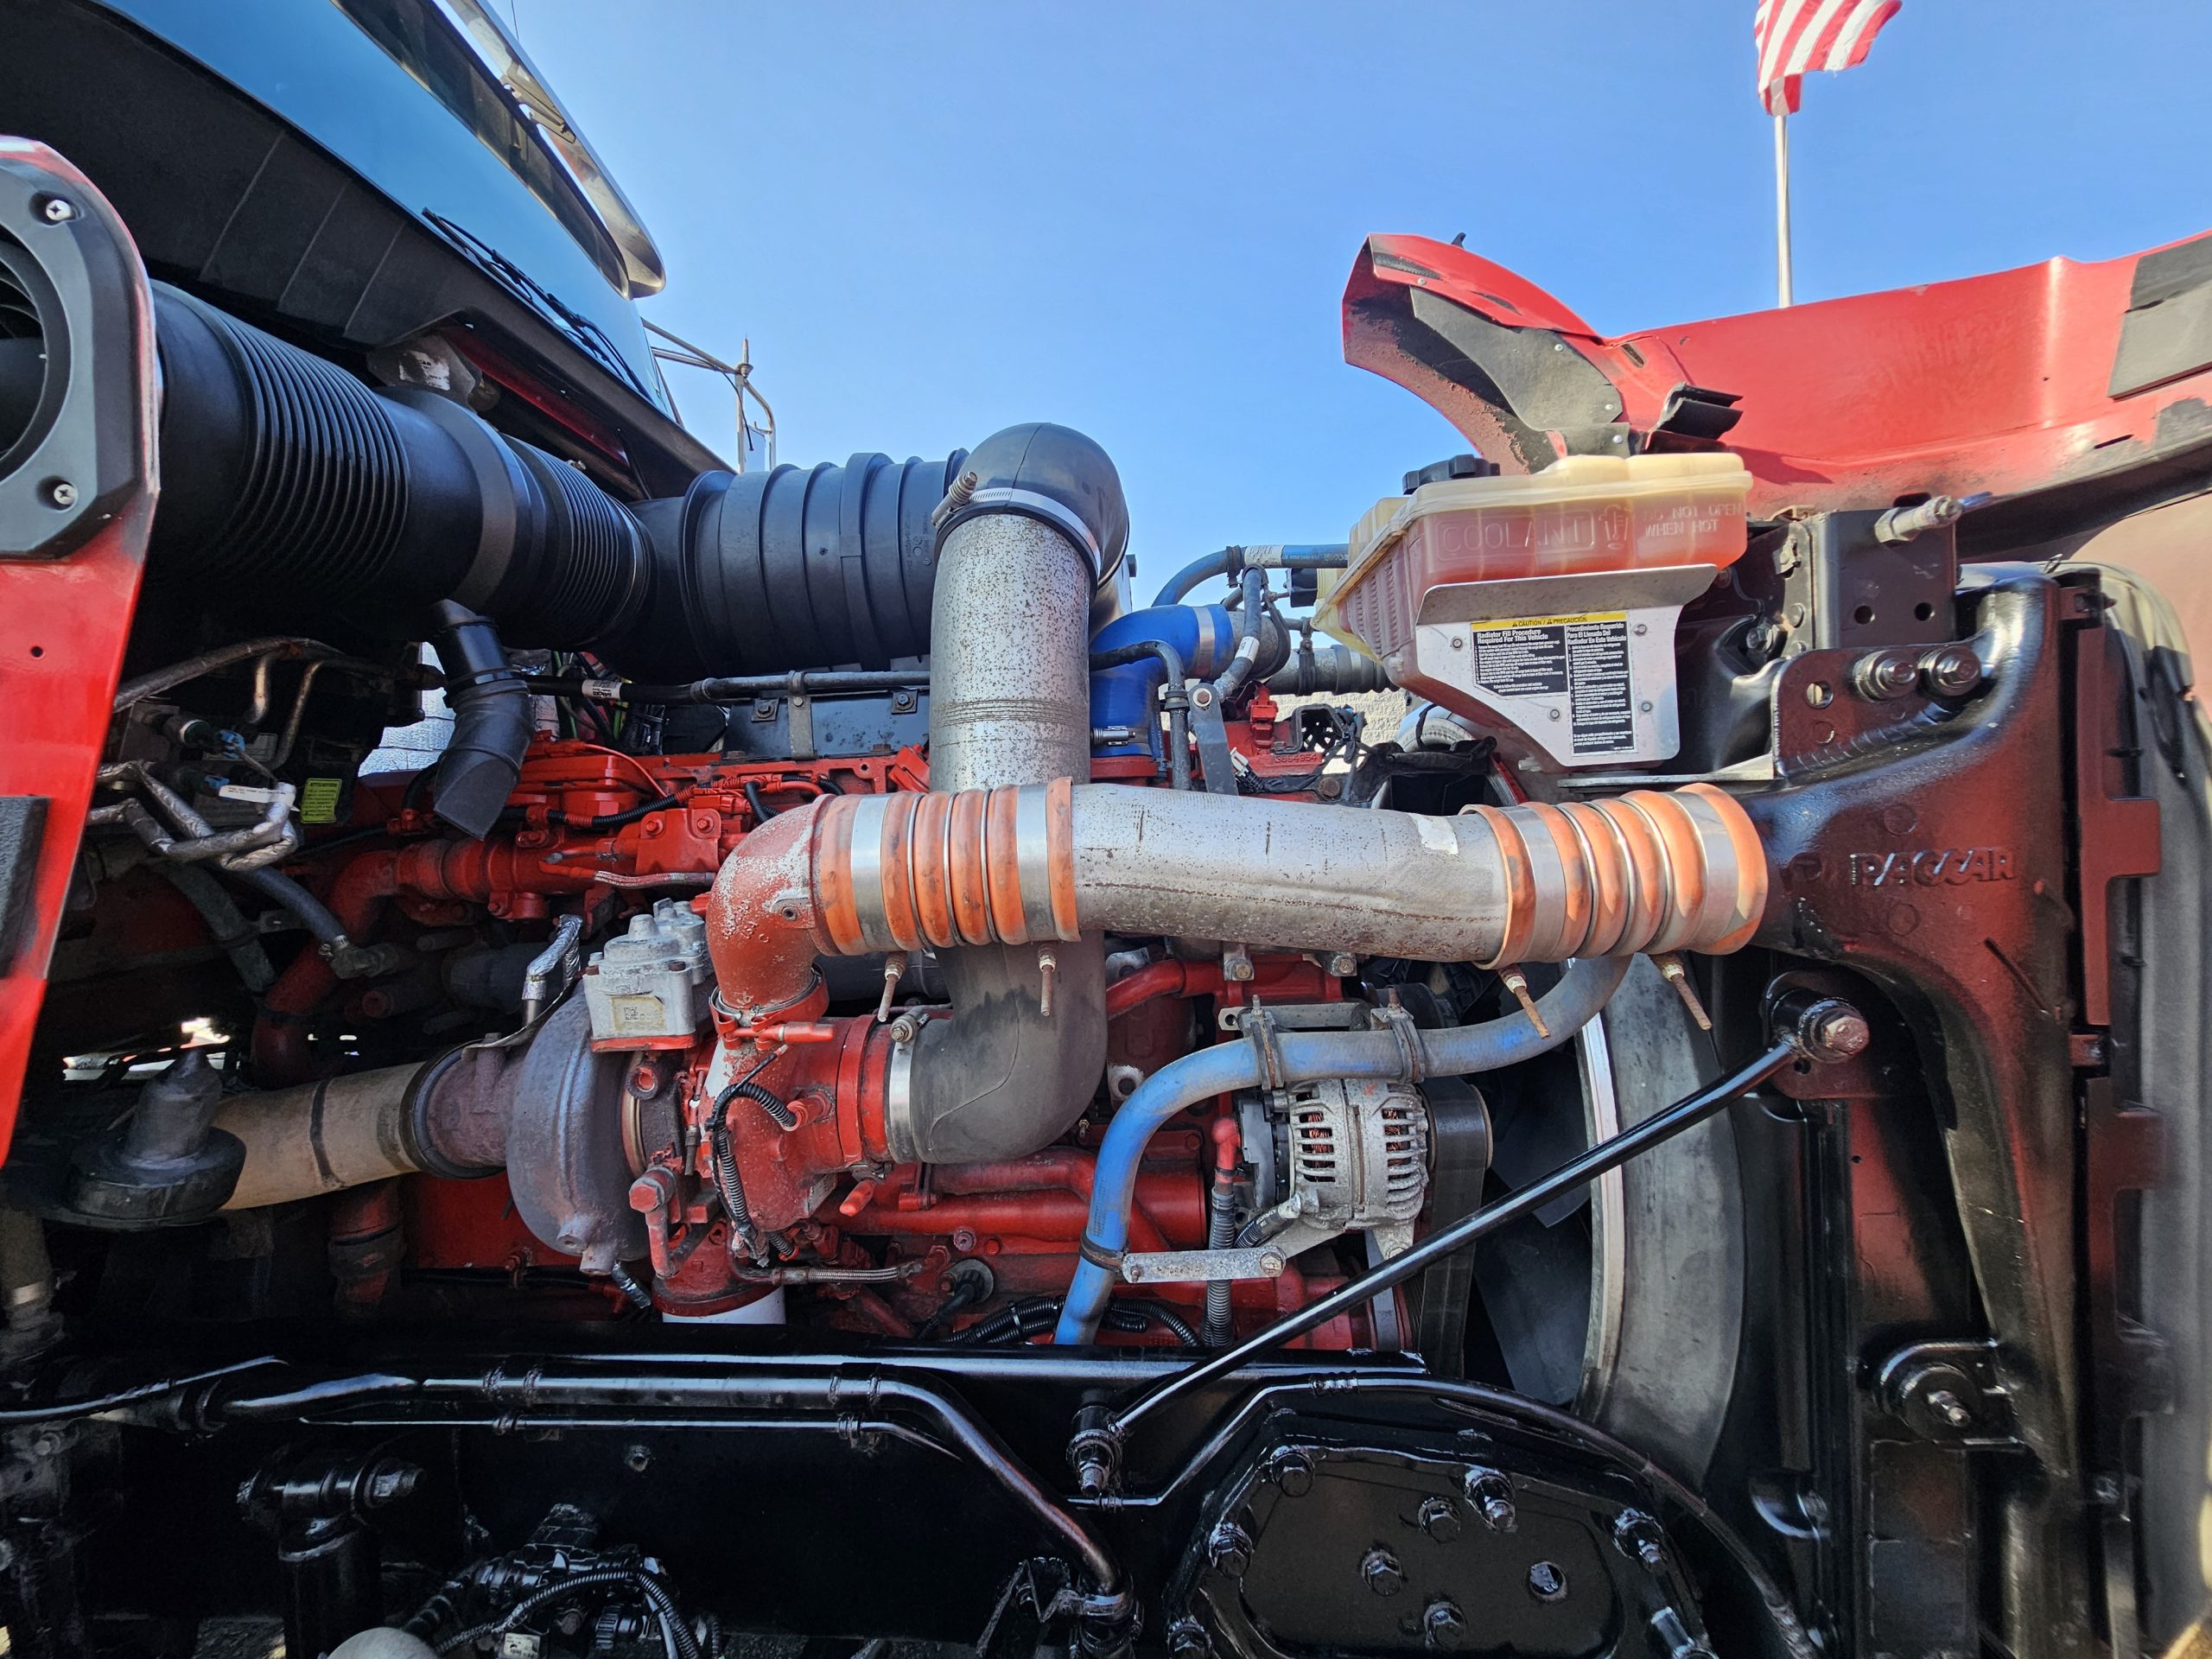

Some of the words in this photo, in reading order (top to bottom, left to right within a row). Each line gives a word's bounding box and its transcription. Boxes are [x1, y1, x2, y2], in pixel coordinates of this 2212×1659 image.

[1673, 505, 1699, 518] NOT
[1708, 503, 1741, 518] OPEN
[1443, 516, 1586, 553] COOLANT
[1644, 520, 1685, 537] WHEN
[1693, 518, 1719, 533] HOT
[1477, 636, 1503, 645] Required
[1849, 846, 2018, 886] PACCAR
